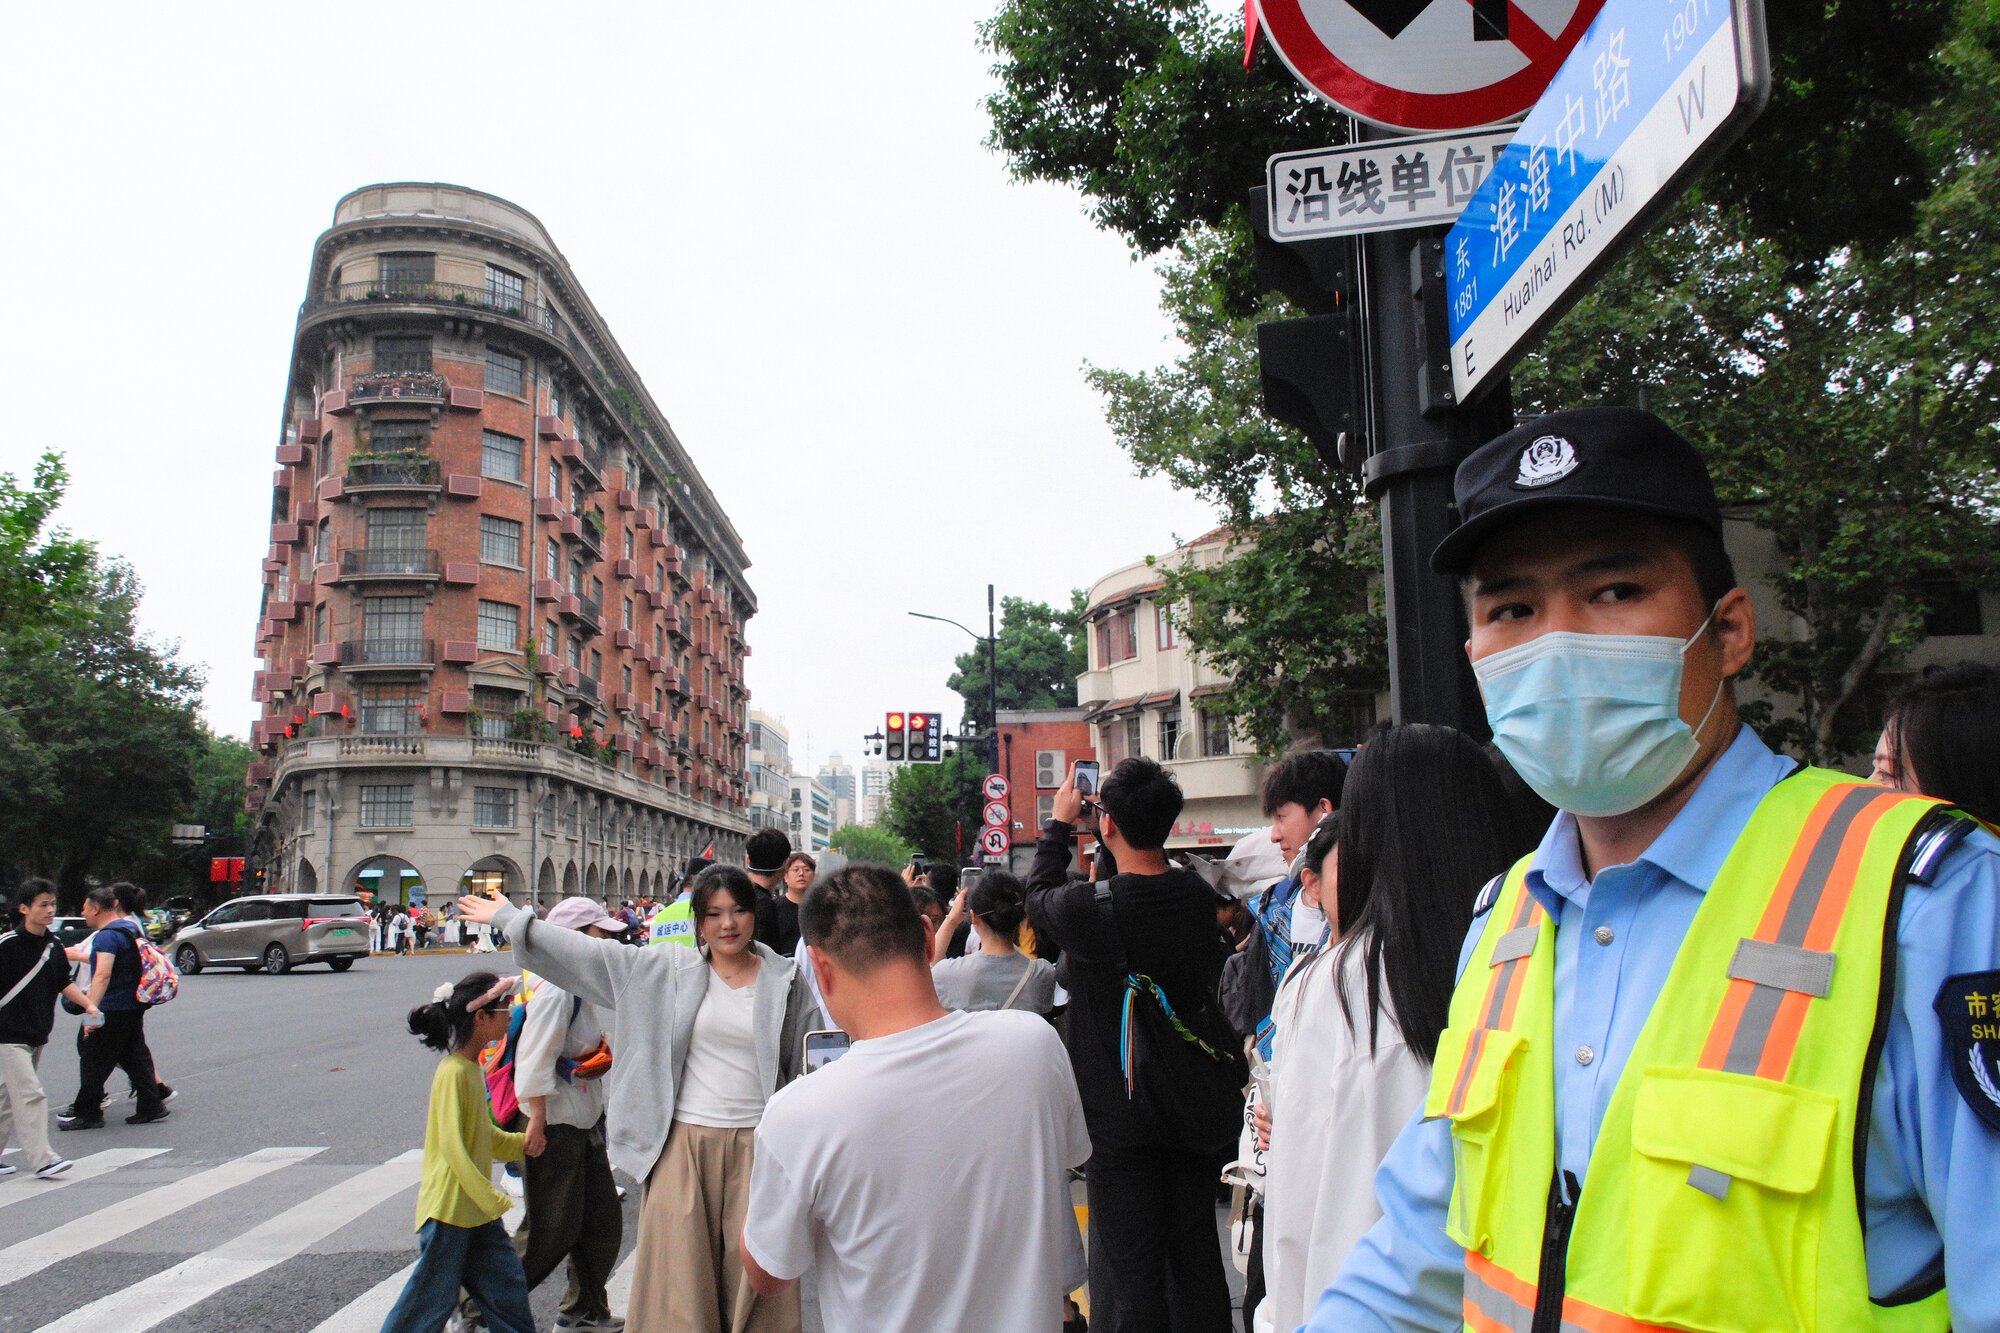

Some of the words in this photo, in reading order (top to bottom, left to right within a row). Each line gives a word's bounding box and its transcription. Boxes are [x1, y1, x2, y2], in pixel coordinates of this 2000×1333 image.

[1677, 64, 1706, 135] W
[1490, 27, 1630, 268] 淮海中路
[1285, 143, 1508, 224] 沿线单位
[1456, 236, 1471, 283] 东
[1503, 243, 1557, 326] Huaihai
[1562, 209, 1591, 260] Rd.
[1594, 164, 1625, 225] (M)
[1453, 275, 1478, 323] 1881
[1464, 338, 1476, 377] E
[1971, 1024, 2000, 1039] SH
